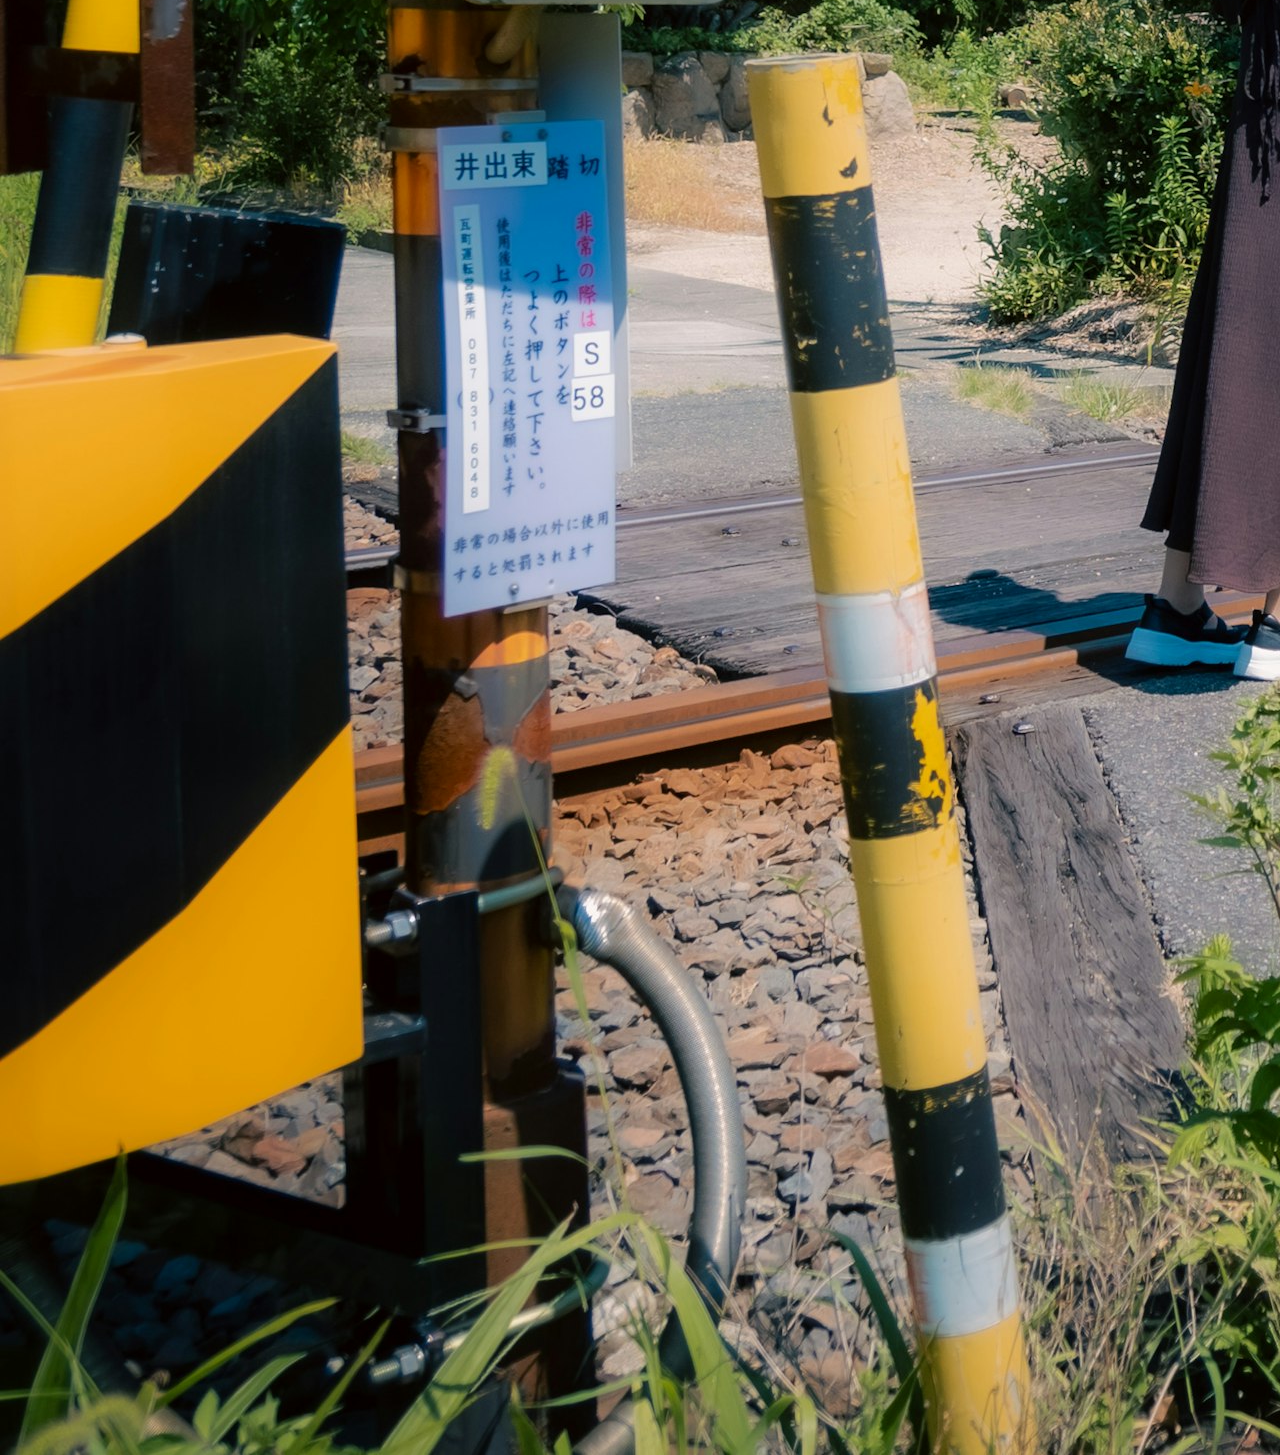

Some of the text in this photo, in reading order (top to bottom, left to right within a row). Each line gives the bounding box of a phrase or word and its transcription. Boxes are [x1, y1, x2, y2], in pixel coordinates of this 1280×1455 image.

[575, 211, 597, 328] 非常の際は
[460, 218, 479, 498] 瓦町運転営業所 087 831 6048
[497, 217, 517, 497] 使用後はただちに左記へ連絡願います
[523, 269, 546, 490] つよく押して下さい。
[551, 264, 571, 405] 上のボタンを
[584, 342, 600, 365] S
[573, 385, 604, 411] 58
[453, 511, 609, 554] 非常の場合以外に使用
[453, 543, 595, 583] すると処罰されます
